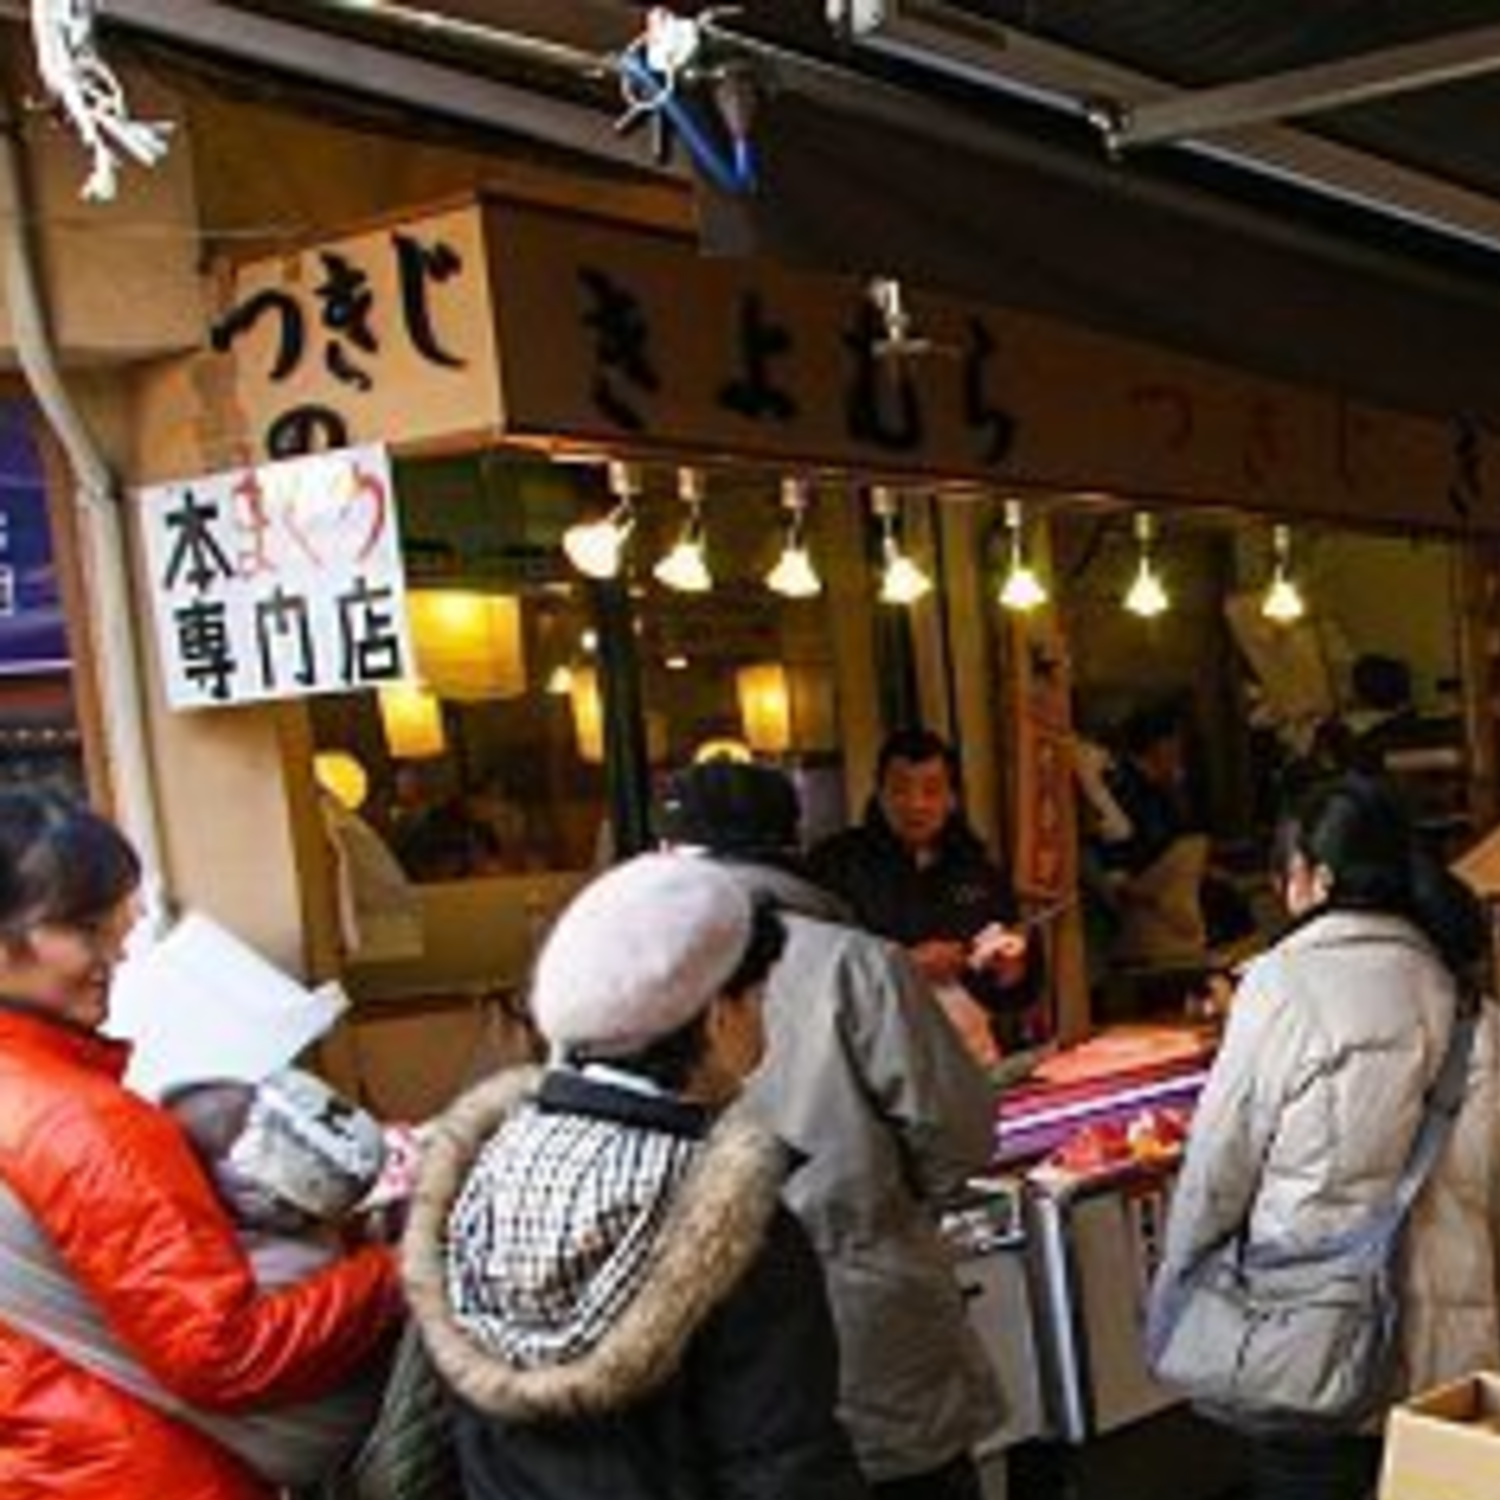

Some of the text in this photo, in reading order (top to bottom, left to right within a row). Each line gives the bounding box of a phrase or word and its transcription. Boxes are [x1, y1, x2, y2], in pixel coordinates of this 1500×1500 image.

[209, 228, 468, 393] つきじ
[174, 576, 402, 700] 専門店
